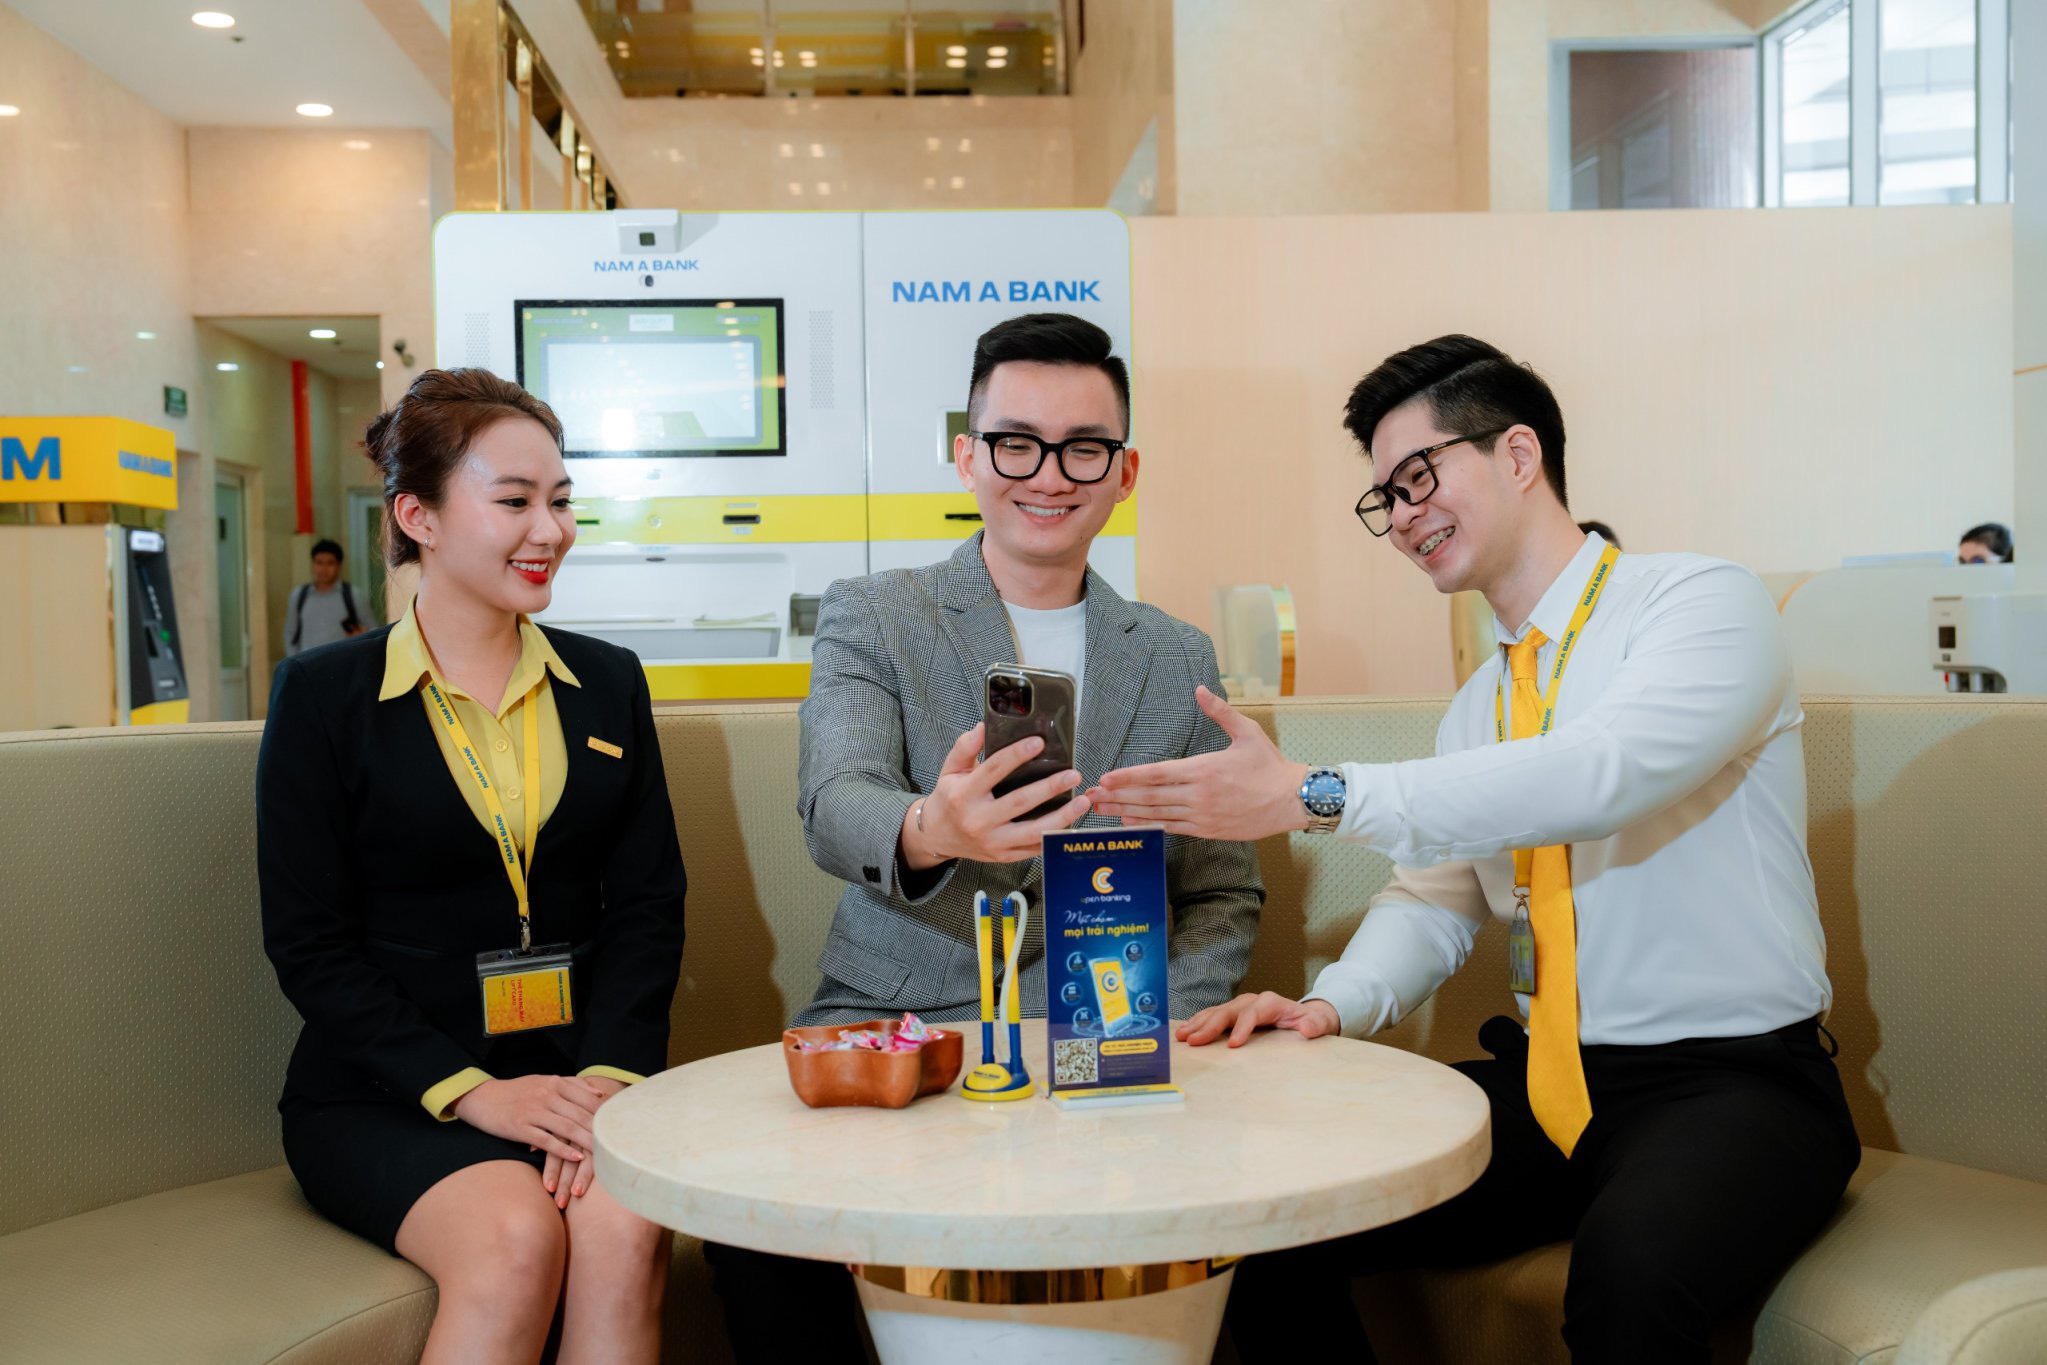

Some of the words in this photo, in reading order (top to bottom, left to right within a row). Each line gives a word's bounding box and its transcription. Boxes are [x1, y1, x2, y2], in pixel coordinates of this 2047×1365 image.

[594, 260, 634, 272] NAM
[638, 260, 649, 271] A
[652, 259, 700, 271] BANK
[892, 281, 971, 303] NAM
[978, 281, 1001, 303] A
[1009, 280, 1101, 302] BANK
[0, 436, 61, 481] M
[1583, 587, 1597, 606] NAM
[1594, 562, 1609, 582] BANK
[1553, 659, 1564, 679] NAM
[1562, 630, 1576, 652] BANK
[429, 683, 443, 703] BANK
[442, 707, 455, 726] NAM
[1541, 707, 1553, 731] BANK
[463, 745, 478, 766] BANK
[476, 769, 489, 789] NAM
[494, 813, 508, 837] BANK
[504, 843, 515, 864] NAM
[1063, 842, 1095, 853] NAM
[1096, 841, 1106, 851] A
[1107, 840, 1144, 851] BANK
[1063, 926, 1084, 939] mọi
[1106, 922, 1150, 937] nghiệm!
